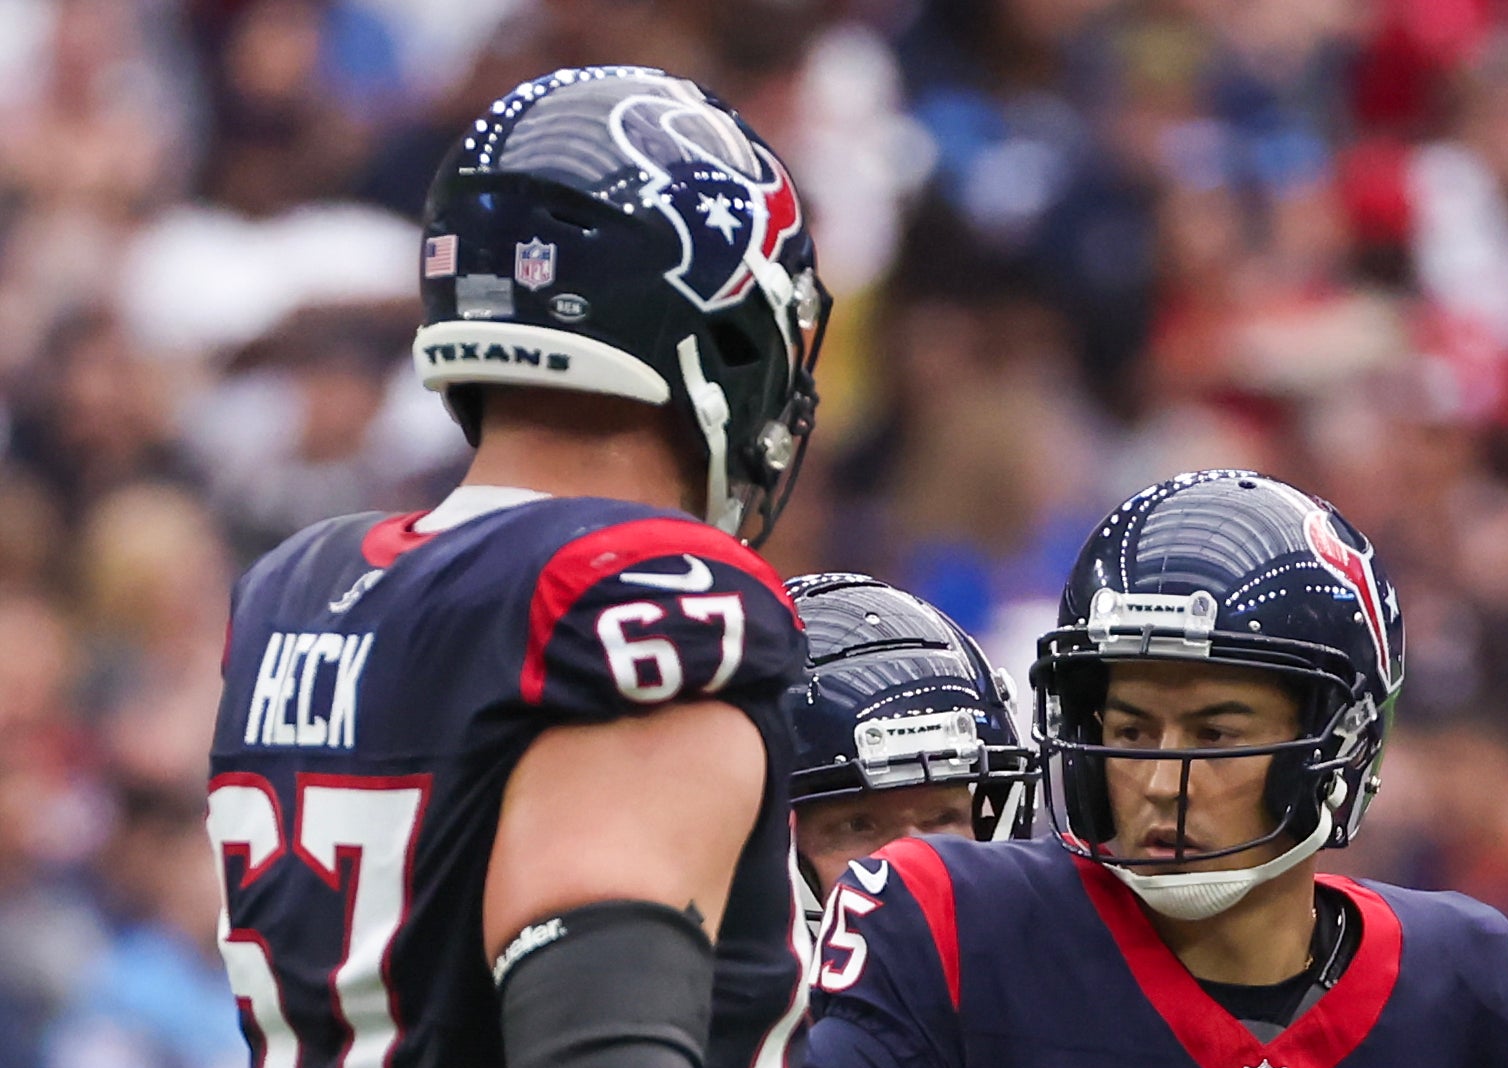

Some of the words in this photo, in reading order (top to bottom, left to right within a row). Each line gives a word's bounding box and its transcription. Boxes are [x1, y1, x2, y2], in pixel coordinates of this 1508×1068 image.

[424, 343, 570, 371] TEXANS
[1126, 603, 1185, 613] TEXANS
[597, 592, 745, 703] 67
[243, 632, 375, 748] HECK
